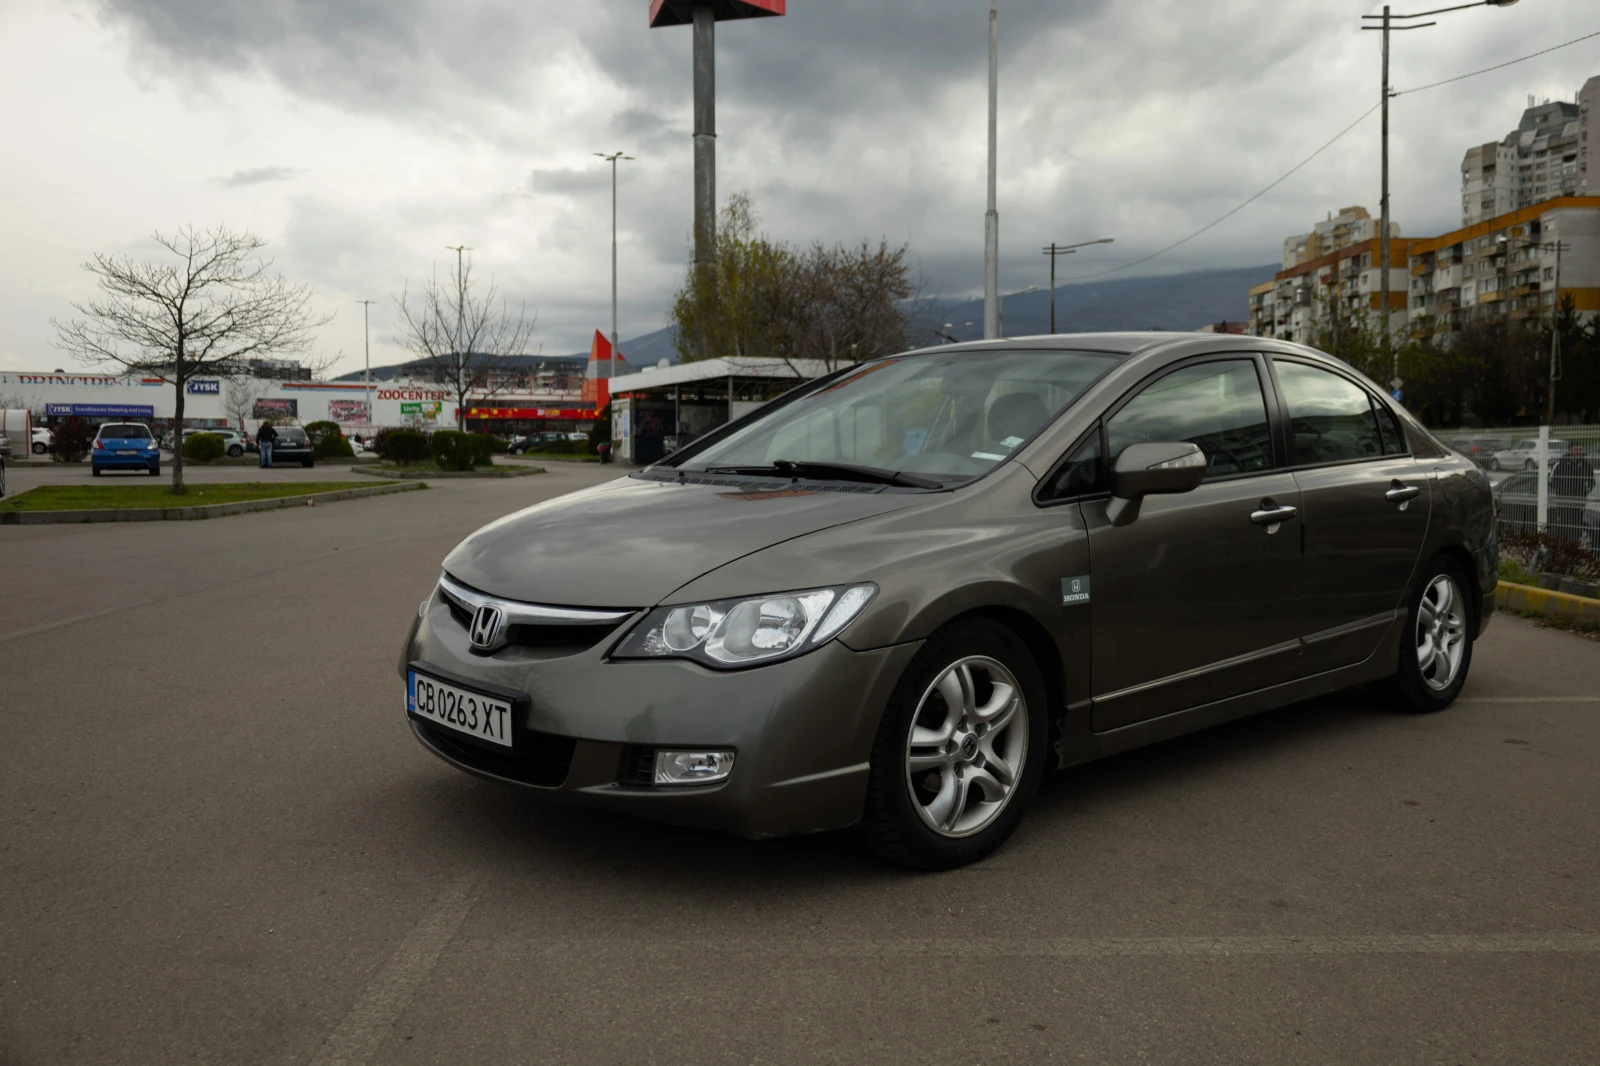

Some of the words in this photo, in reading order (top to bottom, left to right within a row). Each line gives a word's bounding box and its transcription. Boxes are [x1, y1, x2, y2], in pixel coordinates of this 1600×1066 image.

[193, 383, 218, 391] JYSK
[377, 389, 445, 401] ZOOCENTER
[53, 405, 71, 413] JYSK
[108, 406, 128, 415] Sleeping
[129, 406, 137, 414] and
[138, 407, 152, 415] Living
[1063, 592, 1090, 602] HONDA
